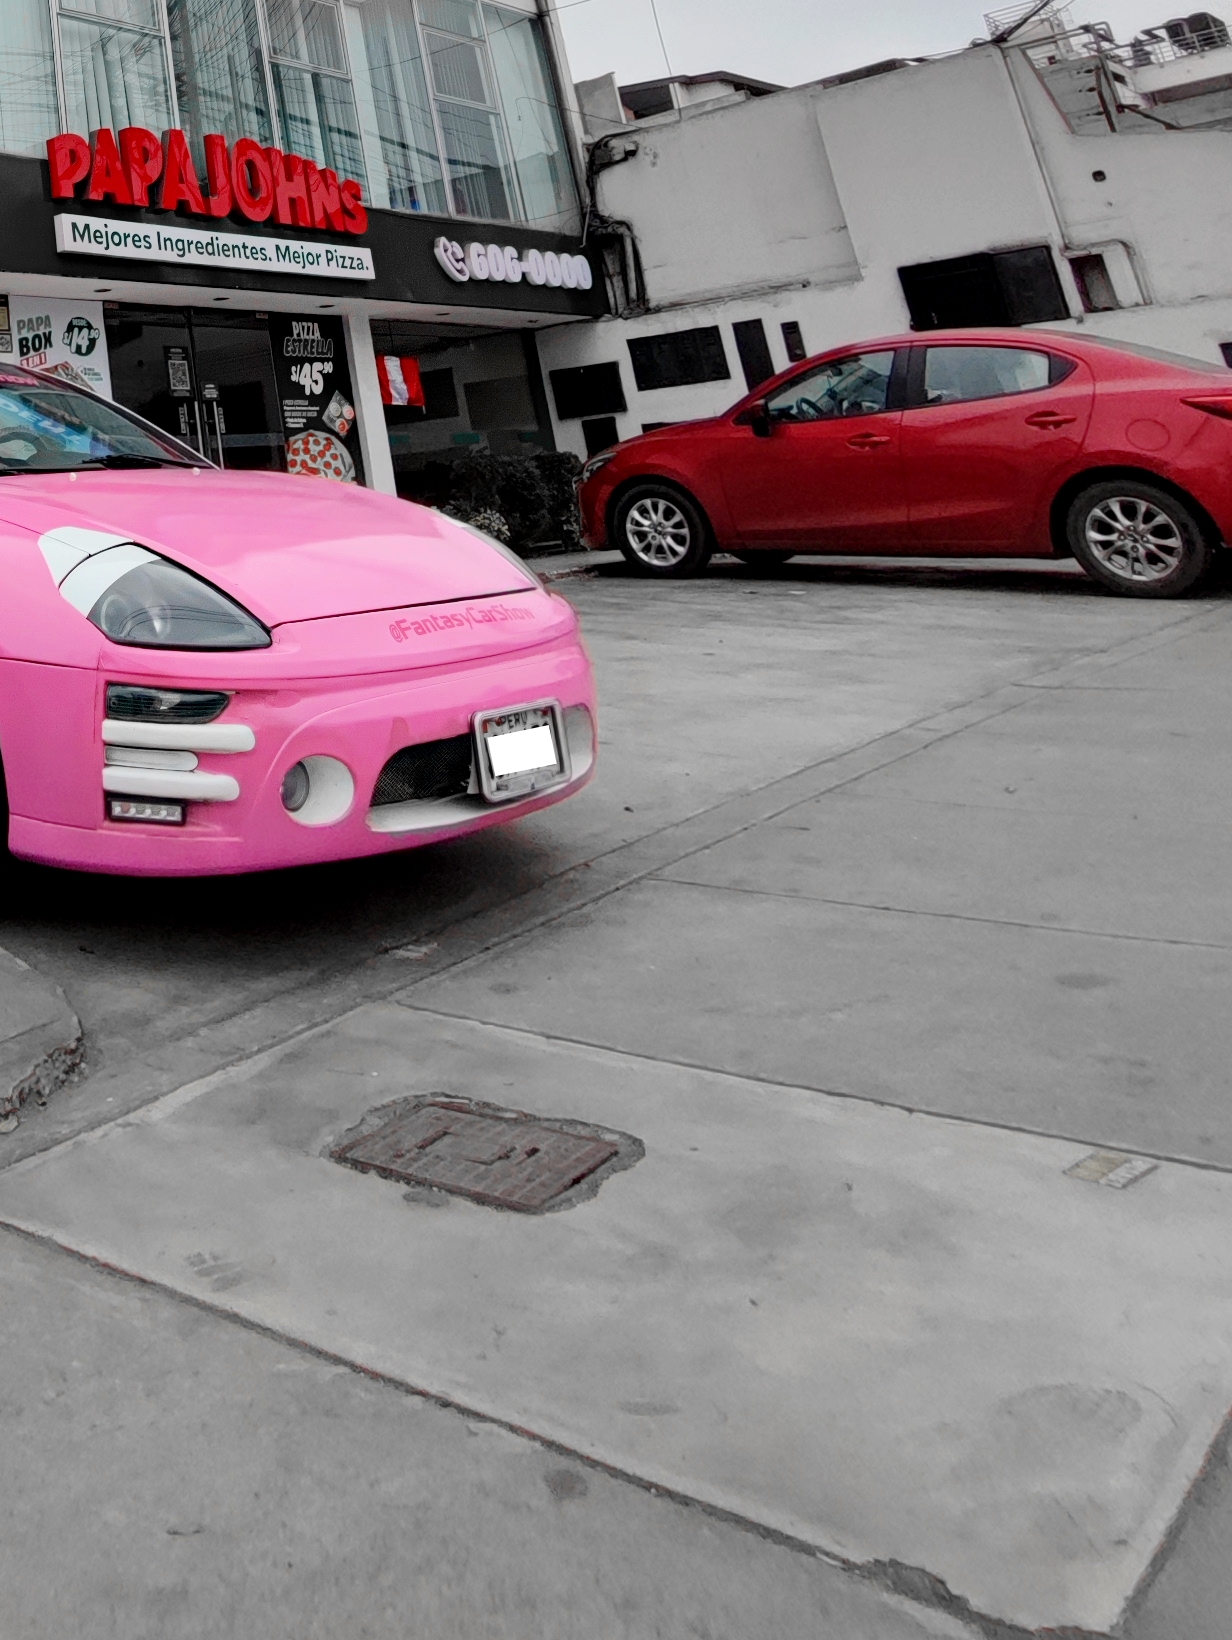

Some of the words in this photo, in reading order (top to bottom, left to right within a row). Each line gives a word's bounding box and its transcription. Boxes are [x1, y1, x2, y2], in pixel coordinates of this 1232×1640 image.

[71, 221, 152, 251] Mejores
[157, 231, 272, 262] Ingredientes.
[275, 244, 322, 269] Mejor
[325, 248, 369, 271] Pizza.
[465, 241, 593, 290] 606-0000
[16, 315, 52, 335] PAPA
[292, 321, 321, 339] PIZZA
[18, 331, 53, 358] BOX
[284, 337, 333, 358] ESTRELLA
[389, 604, 535, 643] @FantasyCarShow
